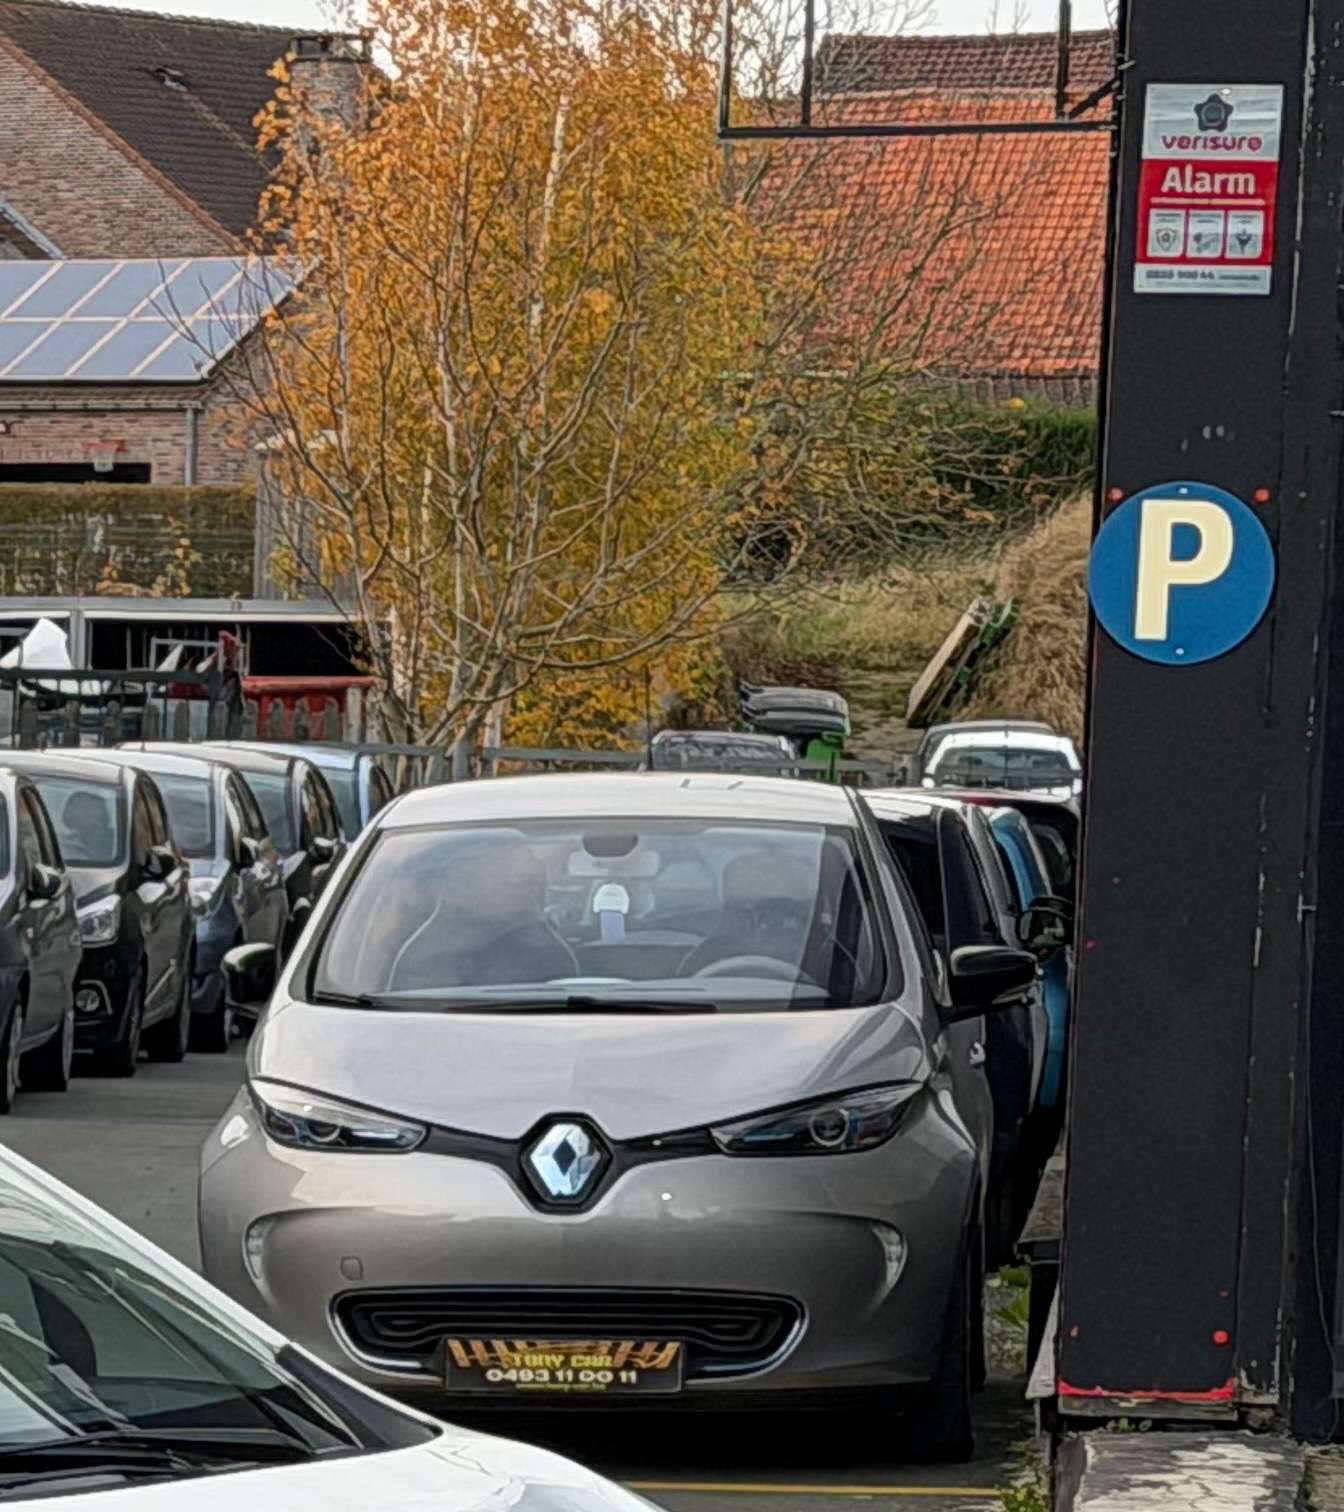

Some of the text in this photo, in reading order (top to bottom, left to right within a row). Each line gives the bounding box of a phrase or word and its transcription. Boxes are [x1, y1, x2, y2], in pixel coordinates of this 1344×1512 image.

[1161, 134, 1263, 152] verisure
[1161, 163, 1256, 195] Alarm
[1134, 499, 1234, 641] P
[486, 1368, 638, 1384] 0493 11 00 11
